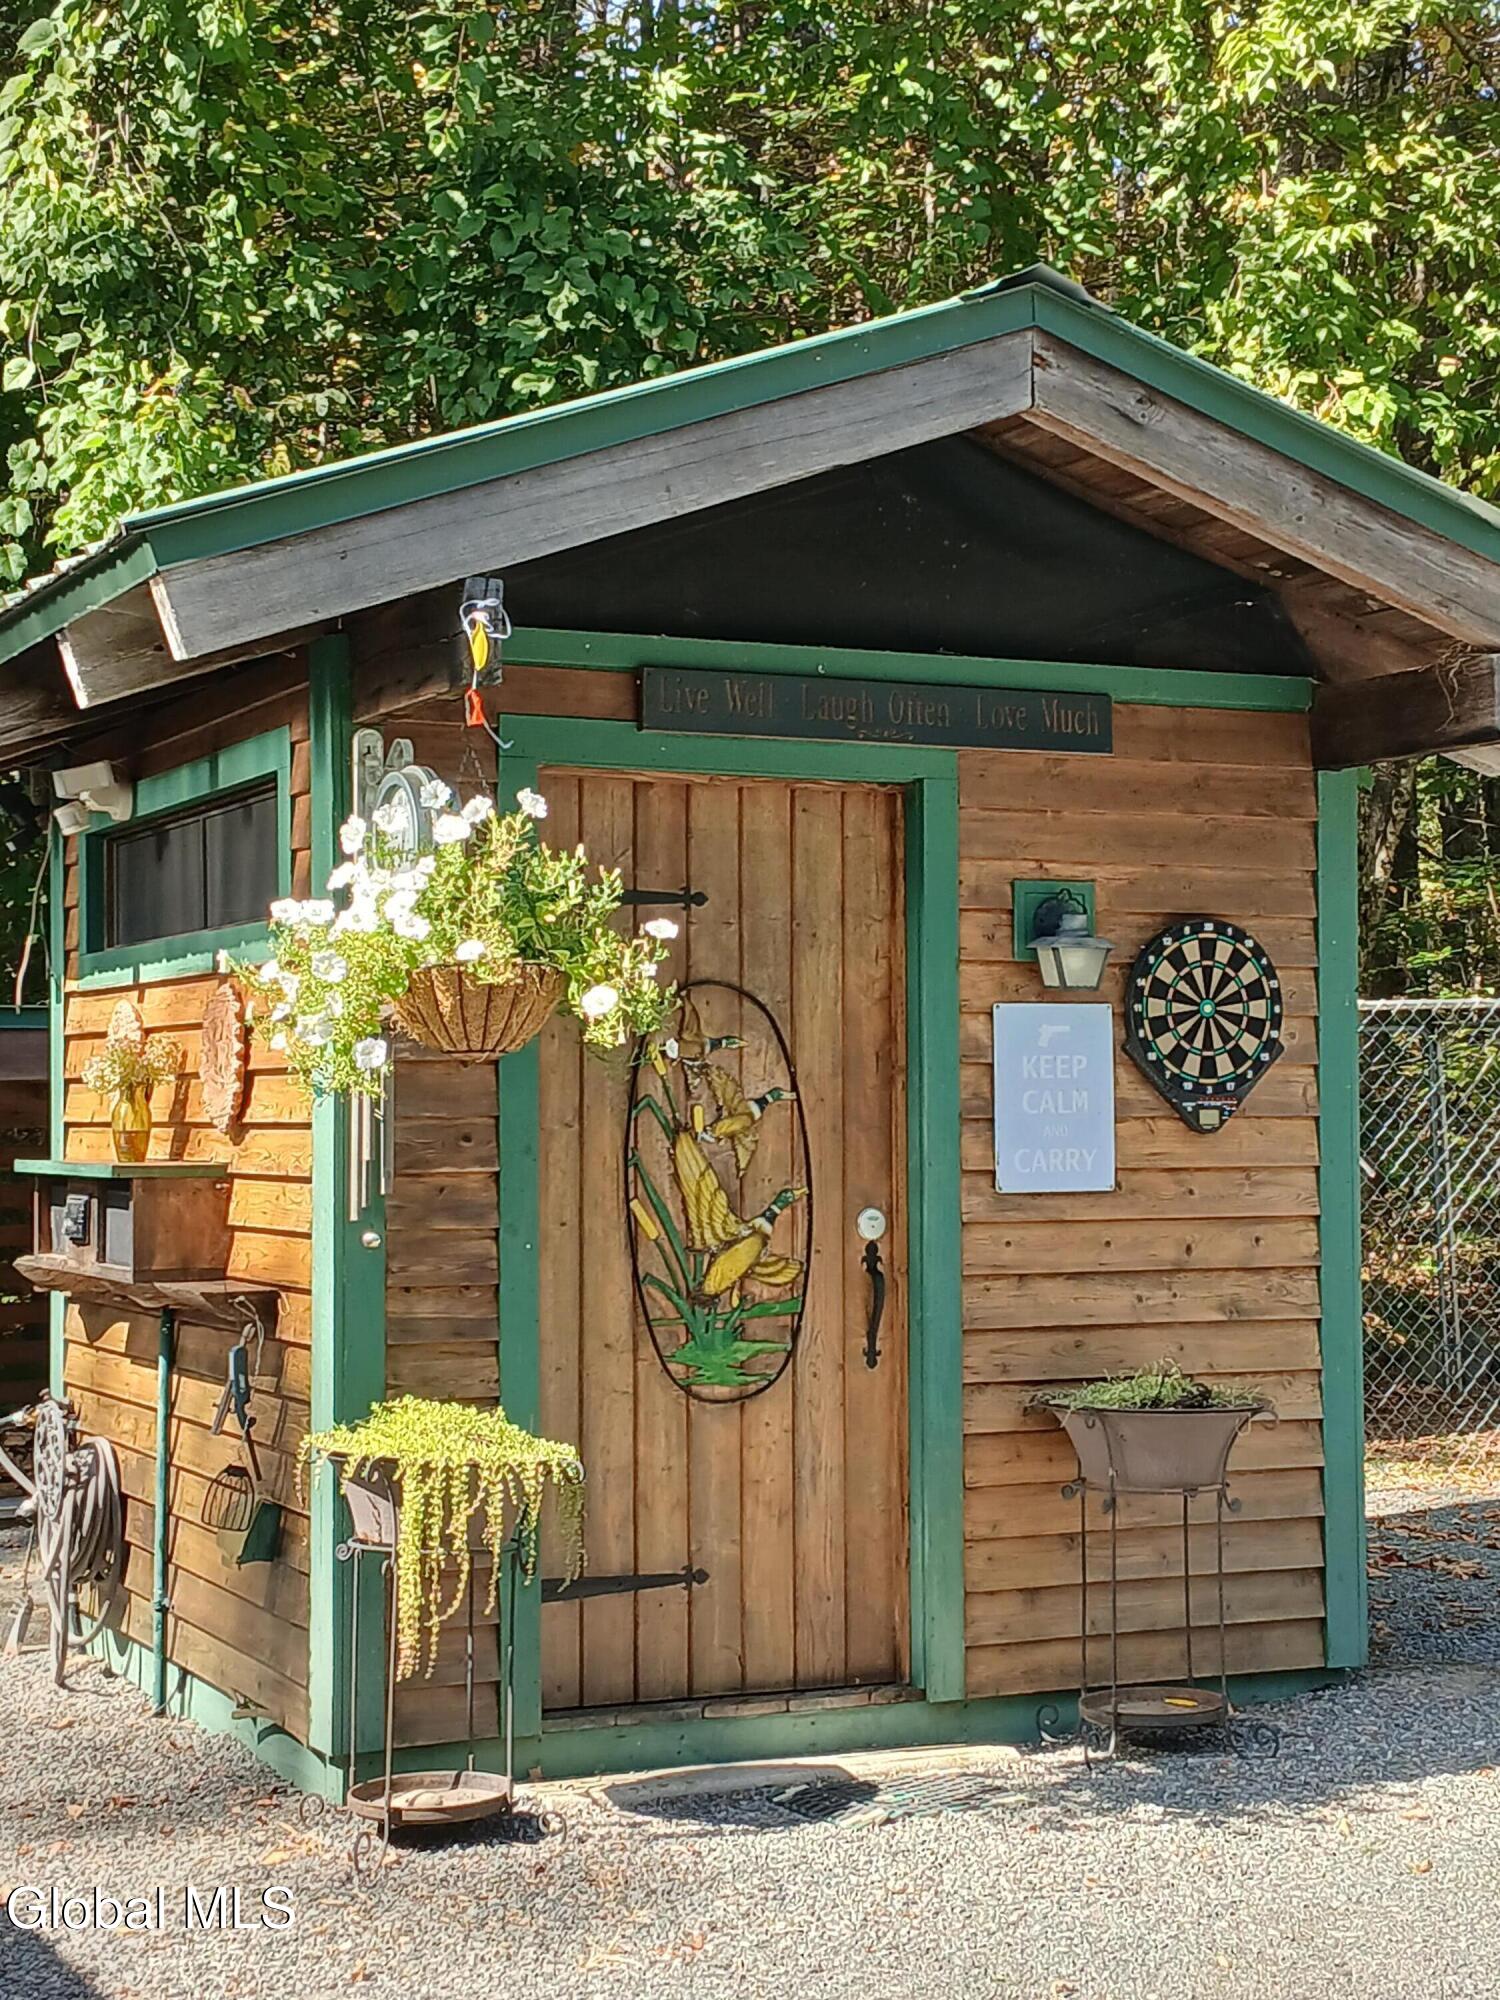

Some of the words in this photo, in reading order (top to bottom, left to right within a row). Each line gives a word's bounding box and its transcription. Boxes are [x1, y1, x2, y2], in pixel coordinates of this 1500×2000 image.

[658, 675, 710, 714] Live
[724, 679, 775, 718] Well
[800, 683, 875, 730] Laugh
[888, 690, 951, 728] Often
[976, 694, 1027, 731] Love
[1041, 698, 1100, 736] Much
[1022, 1055, 1088, 1079] KEEP
[1022, 1089, 1089, 1114] CALM
[1043, 1125, 1069, 1137] AND
[1013, 1148, 1097, 1173] CARRY
